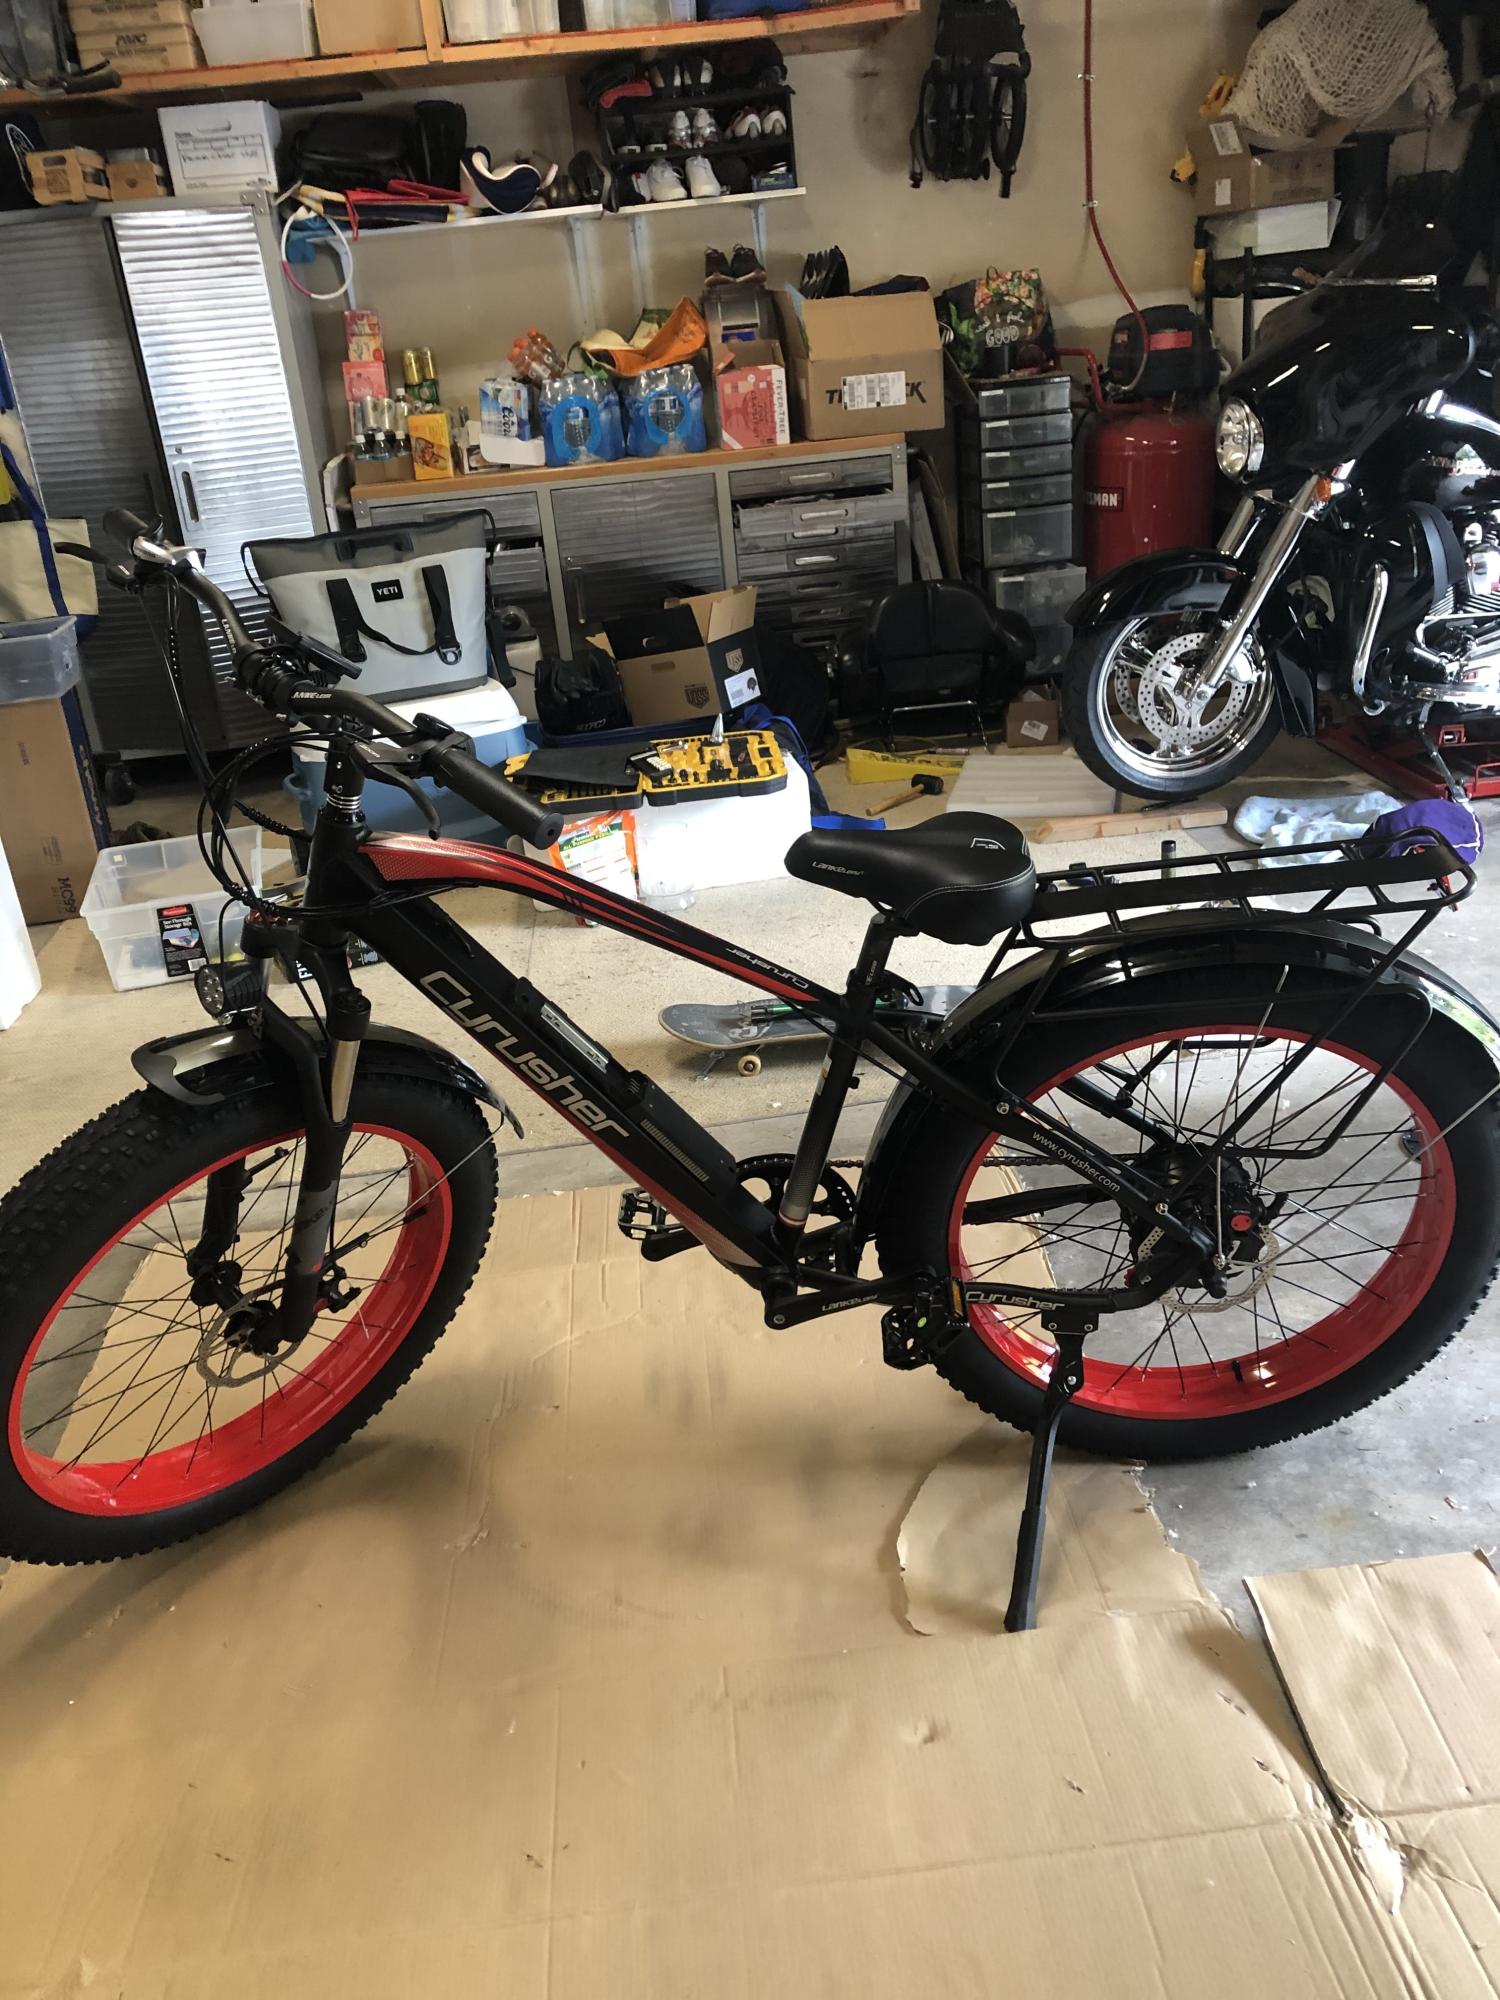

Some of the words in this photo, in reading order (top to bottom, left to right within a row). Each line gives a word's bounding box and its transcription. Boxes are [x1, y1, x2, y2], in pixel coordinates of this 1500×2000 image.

[985, 325, 1020, 347] GOOD
[376, 585, 399, 596] YETI
[726, 947, 809, 990] Cyrusher
[419, 970, 630, 1138] Cyrusher
[1032, 1131, 1121, 1193] www.cyrusher.com
[965, 1290, 1065, 1311] Cyrusher
